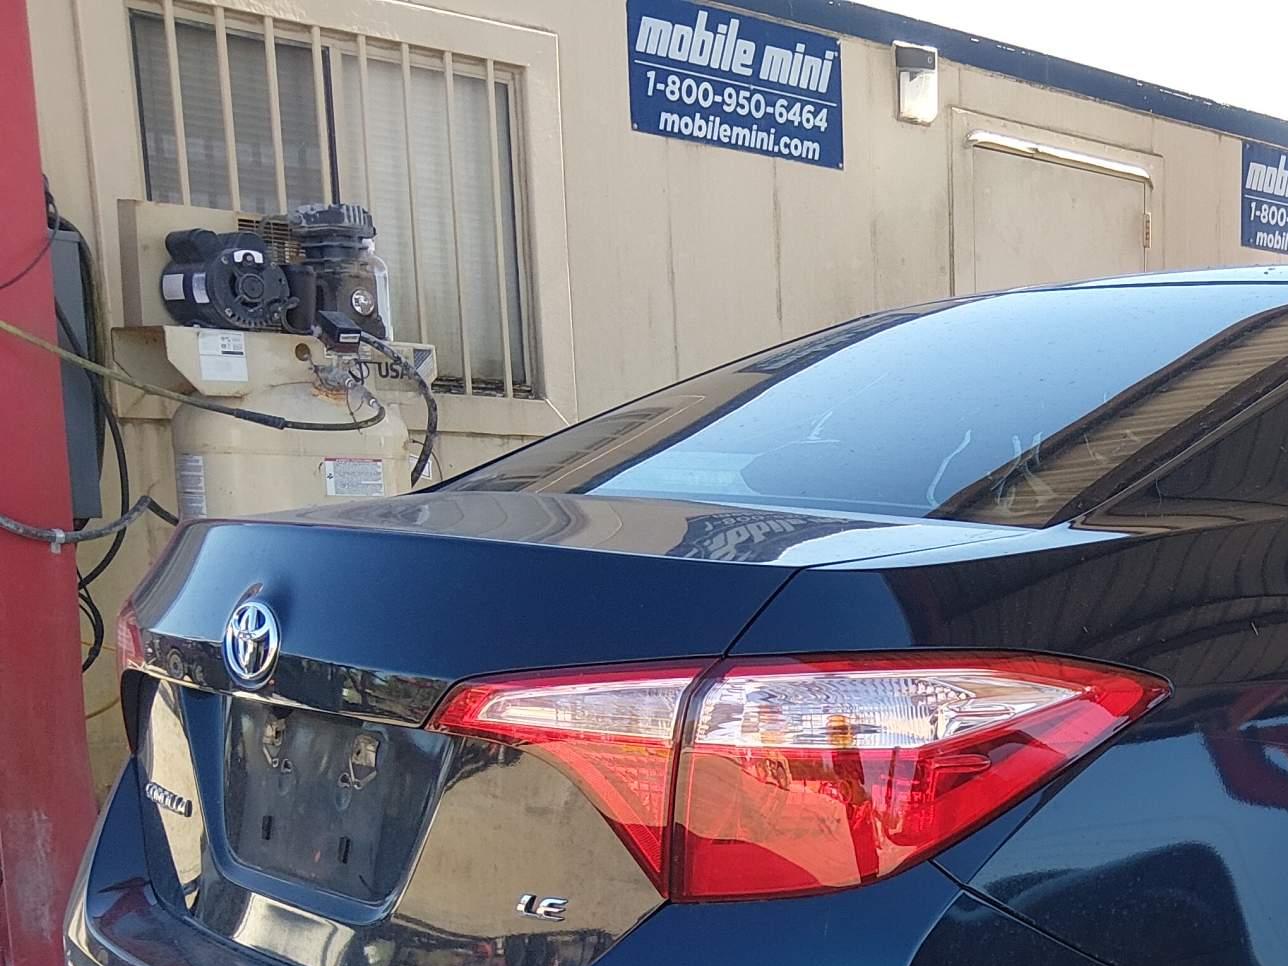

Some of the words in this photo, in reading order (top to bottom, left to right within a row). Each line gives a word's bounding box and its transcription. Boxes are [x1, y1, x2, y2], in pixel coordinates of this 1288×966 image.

[635, 10, 756, 76] mobile
[759, 43, 834, 94] mini
[646, 71, 828, 132] 1-800-950-6464
[659, 111, 820, 160] mobilemini.com
[516, 894, 569, 922] LE
